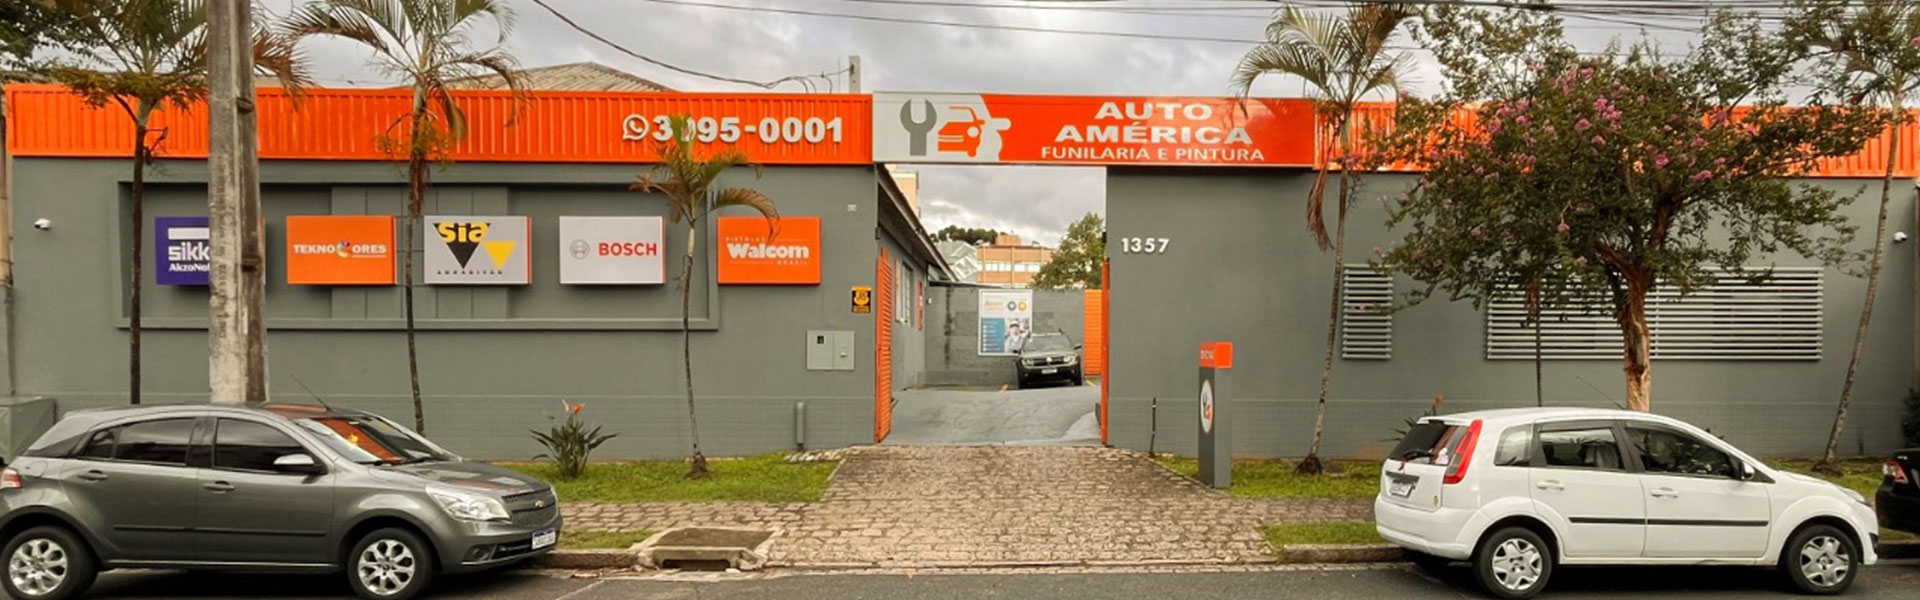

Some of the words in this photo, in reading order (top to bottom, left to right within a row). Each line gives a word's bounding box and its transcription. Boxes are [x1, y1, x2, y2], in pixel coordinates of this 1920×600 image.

[1094, 102, 1212, 120] AUTO
[1054, 121, 1253, 145] AMÉRICA
[1041, 147, 1150, 160] FUNILARIA
[1158, 148, 1167, 160] E
[1176, 148, 1264, 162] PINTURA
[438, 222, 489, 243] sia
[168, 241, 210, 261] sikk
[598, 243, 657, 256] BOSCH
[726, 243, 809, 258] Walcom
[1122, 238, 1169, 253] 1357
